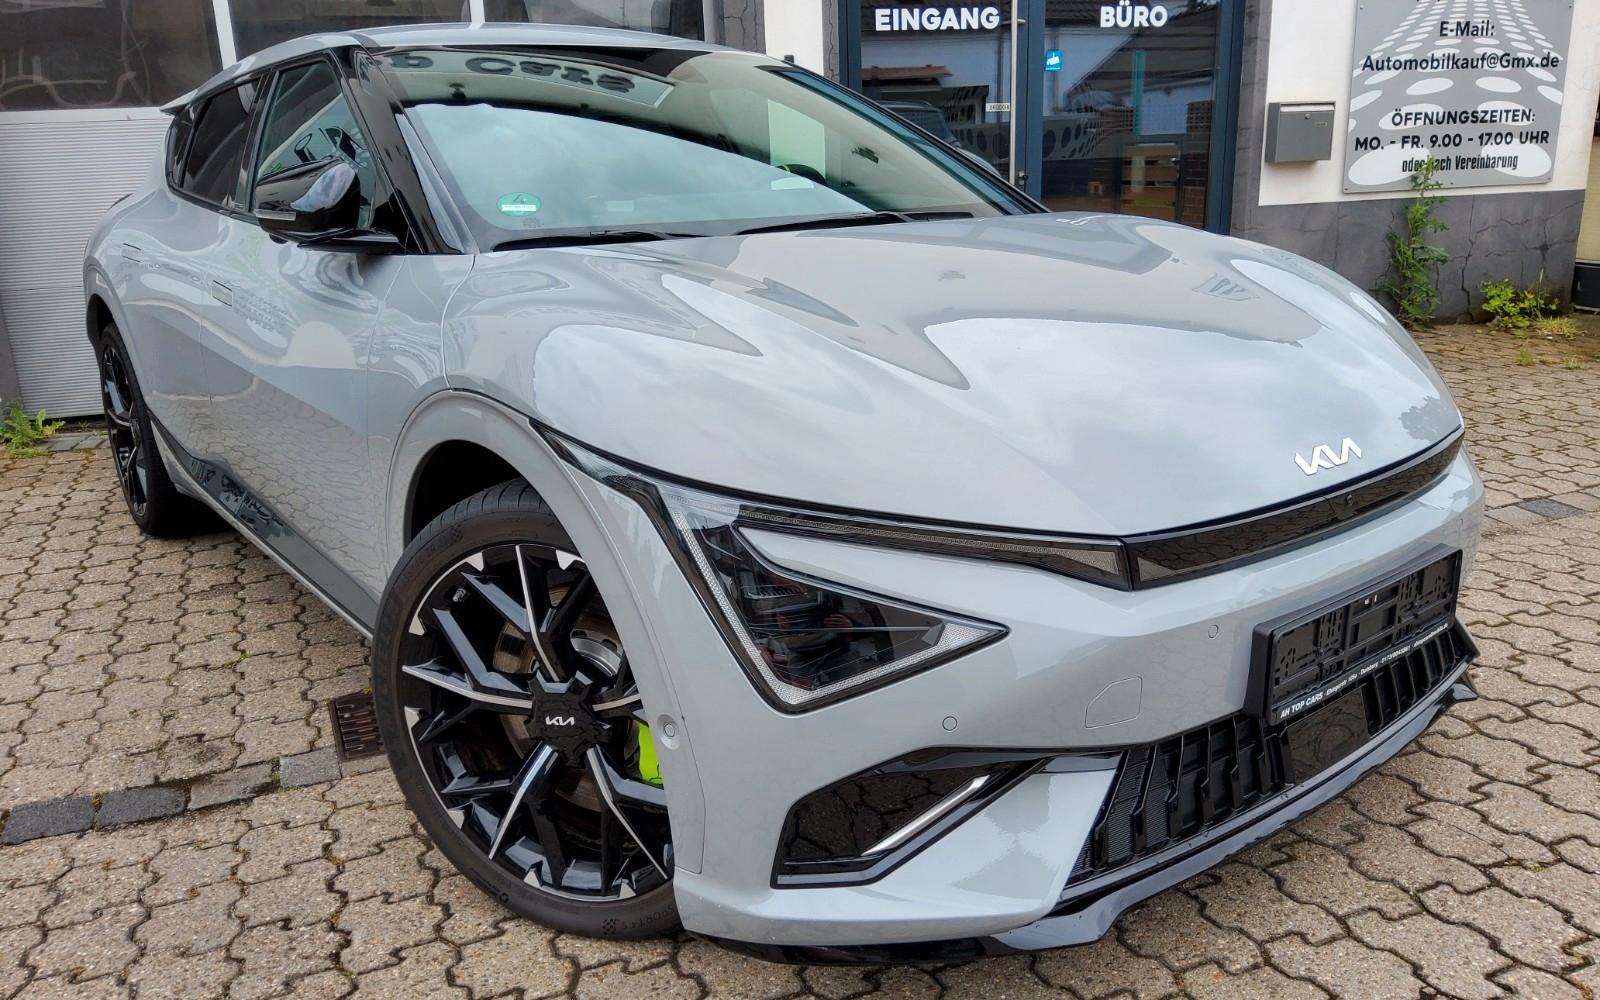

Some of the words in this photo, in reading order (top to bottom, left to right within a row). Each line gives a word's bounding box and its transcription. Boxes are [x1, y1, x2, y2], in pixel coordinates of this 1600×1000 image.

[875, 8, 1000, 31] EINGANG
[1100, 0, 1168, 28] BÜRO
[1439, 20, 1495, 37] E-Mail:
[1362, 52, 1560, 71] Automobilkauf@Gmx.de
[1391, 109, 1536, 126] ÖFFNUNGSZEITEN:
[1355, 136, 1385, 151] MO.
[1401, 134, 1424, 150] FR.
[1430, 133, 1462, 149] 9.00
[1478, 131, 1514, 147] 17.00
[1519, 130, 1550, 145] UHR
[1429, 155, 1451, 172] ach
[1455, 155, 1518, 171] Vereinbarung
[1292, 700, 1305, 713] TOP
[1306, 692, 1324, 706] CARS
